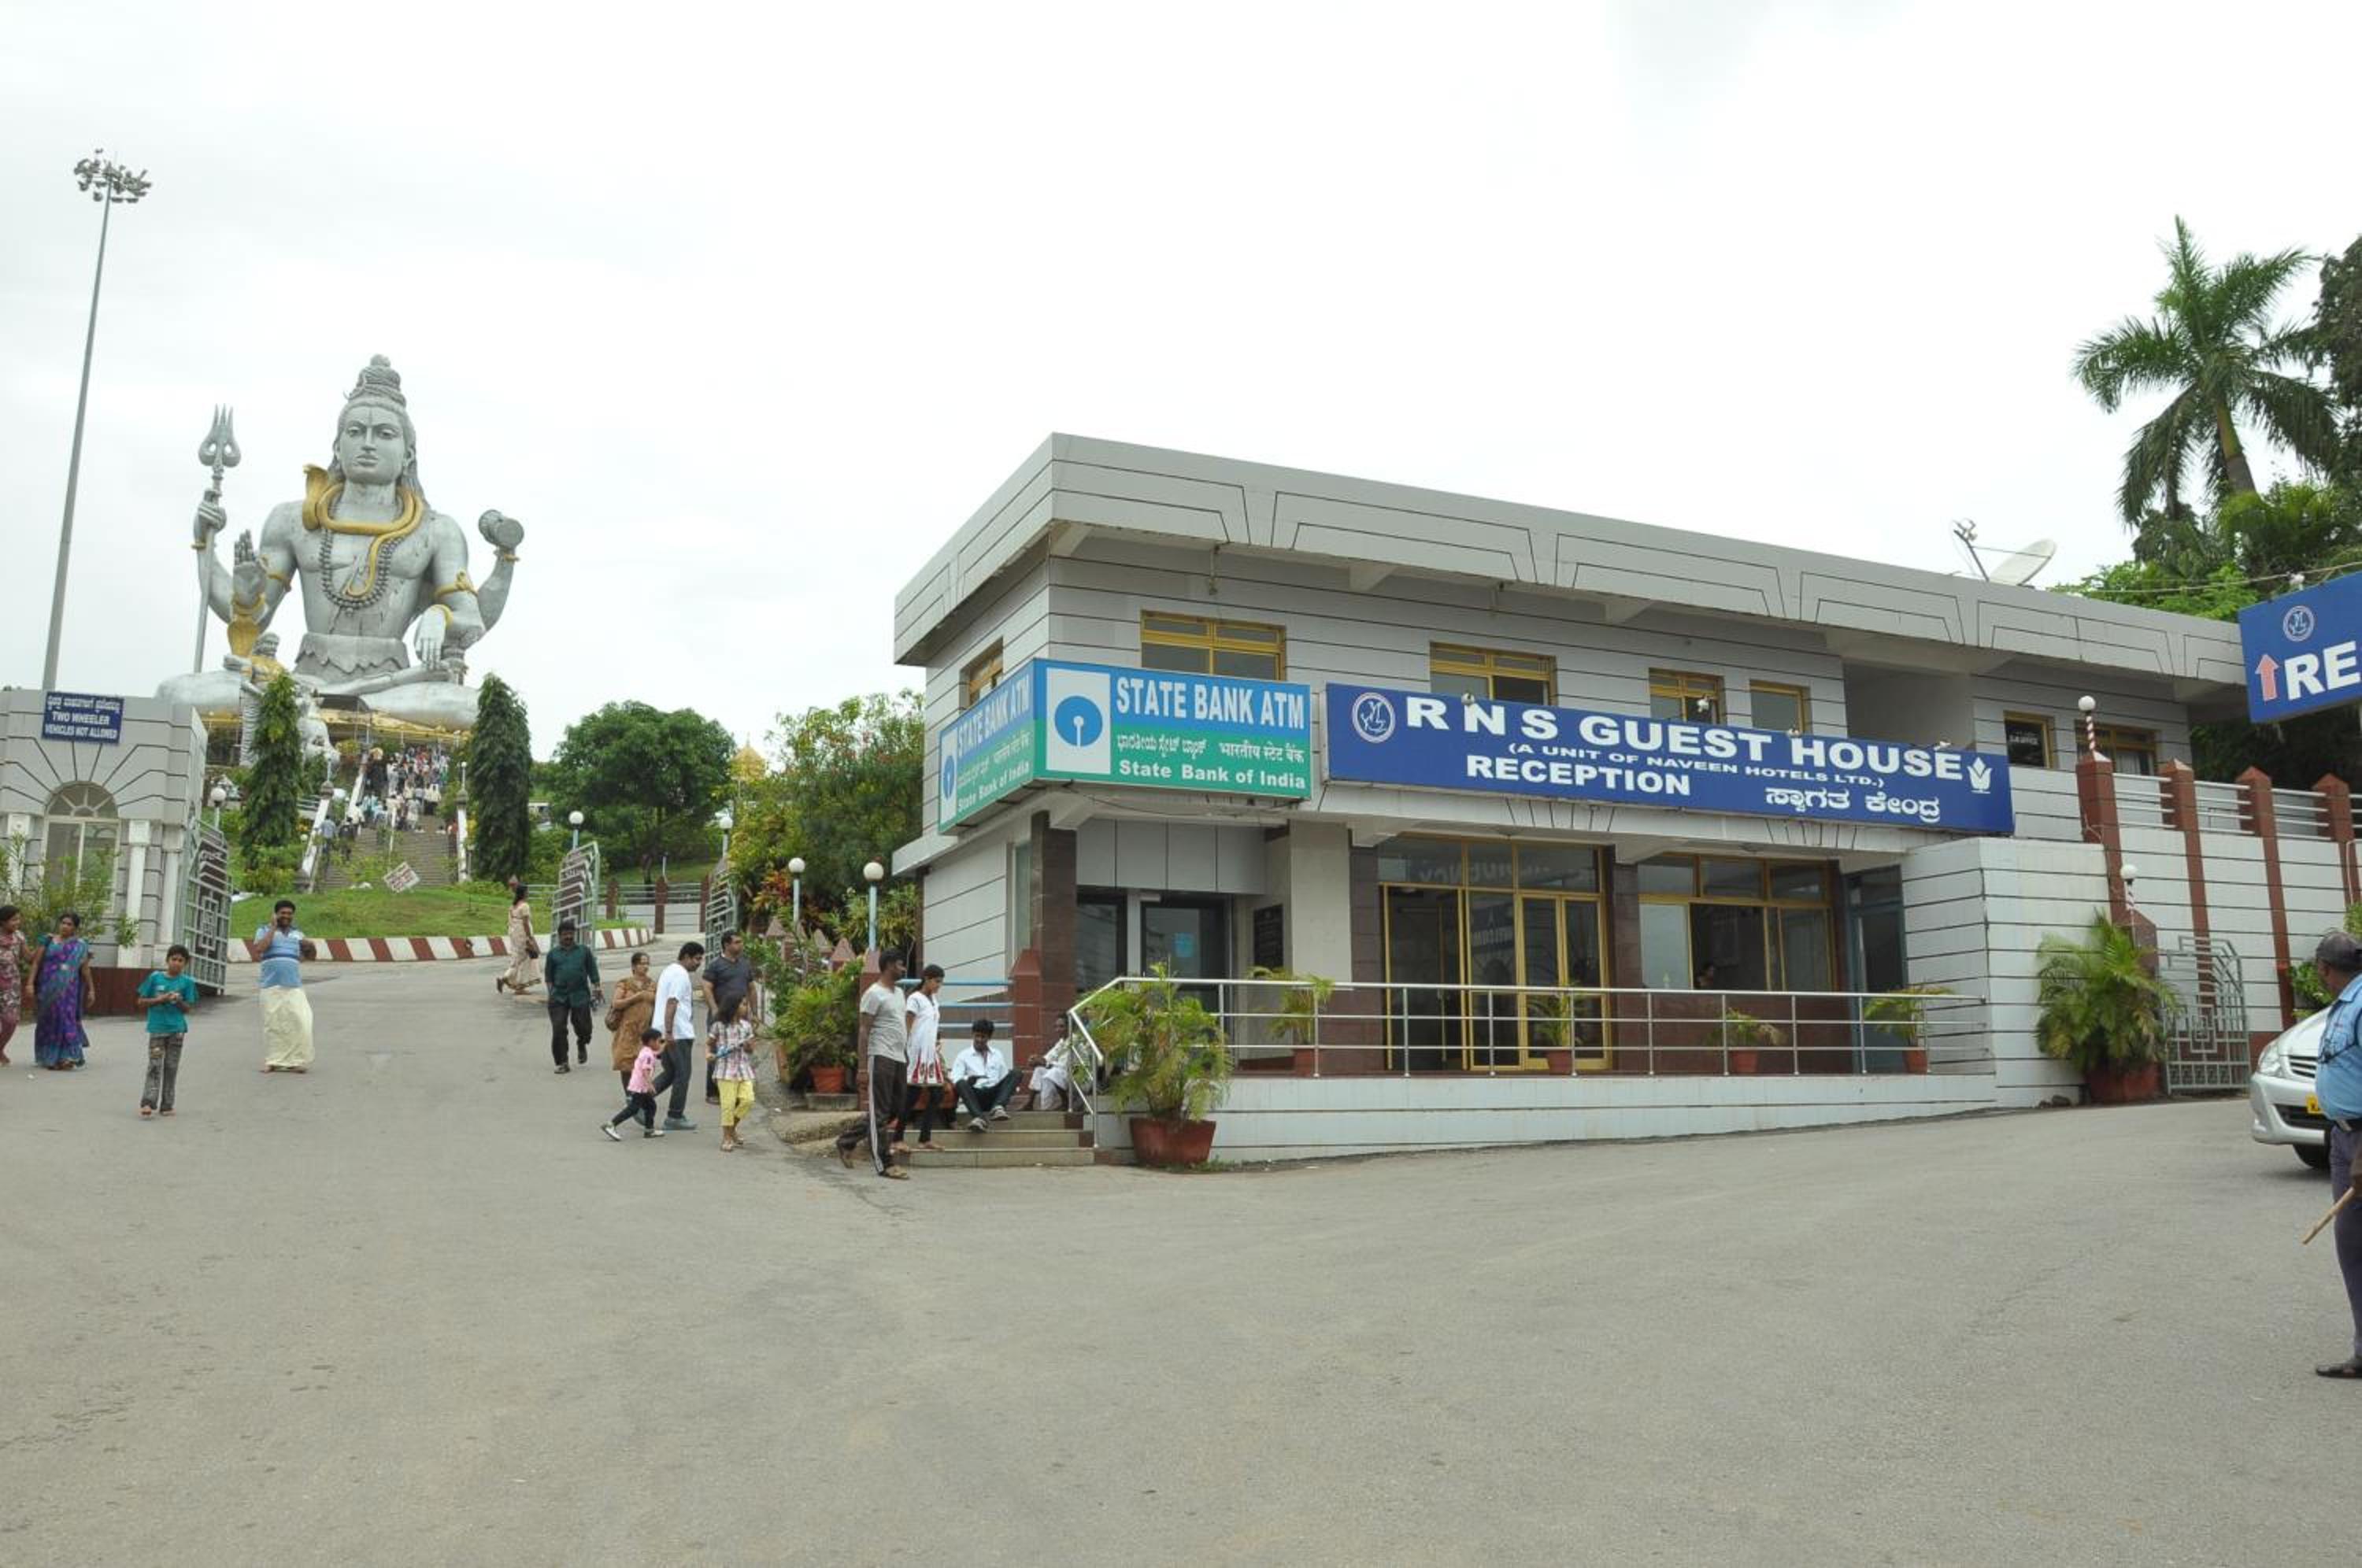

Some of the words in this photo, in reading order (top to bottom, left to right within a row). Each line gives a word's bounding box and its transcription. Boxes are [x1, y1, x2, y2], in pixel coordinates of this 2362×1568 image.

[52, 711, 70, 723] TWO
[72, 712, 110, 726] WHEELER
[957, 708, 984, 759] STATE
[984, 690, 1009, 741] BANK
[1010, 673, 1031, 720] ATM
[1116, 677, 1187, 719] STATE
[1194, 684, 1254, 725] BANK
[1261, 690, 1305, 730] ATM
[1542, 745, 1601, 760] UNIT
[1609, 752, 1639, 765] OF
[1646, 755, 1738, 775] NAVEEN
[1744, 766, 1830, 783] HOTELS
[1579, 715, 1773, 762] GUEST
[1791, 738, 1964, 781] HOUSE
[1119, 759, 1172, 778] State
[1181, 764, 1229, 783] Bank
[1235, 769, 1255, 785] of
[1260, 771, 1306, 790] India
[1466, 754, 1690, 797] RECEPTION
[1864, 790, 1942, 823] ಕೇಂದ್ರ
